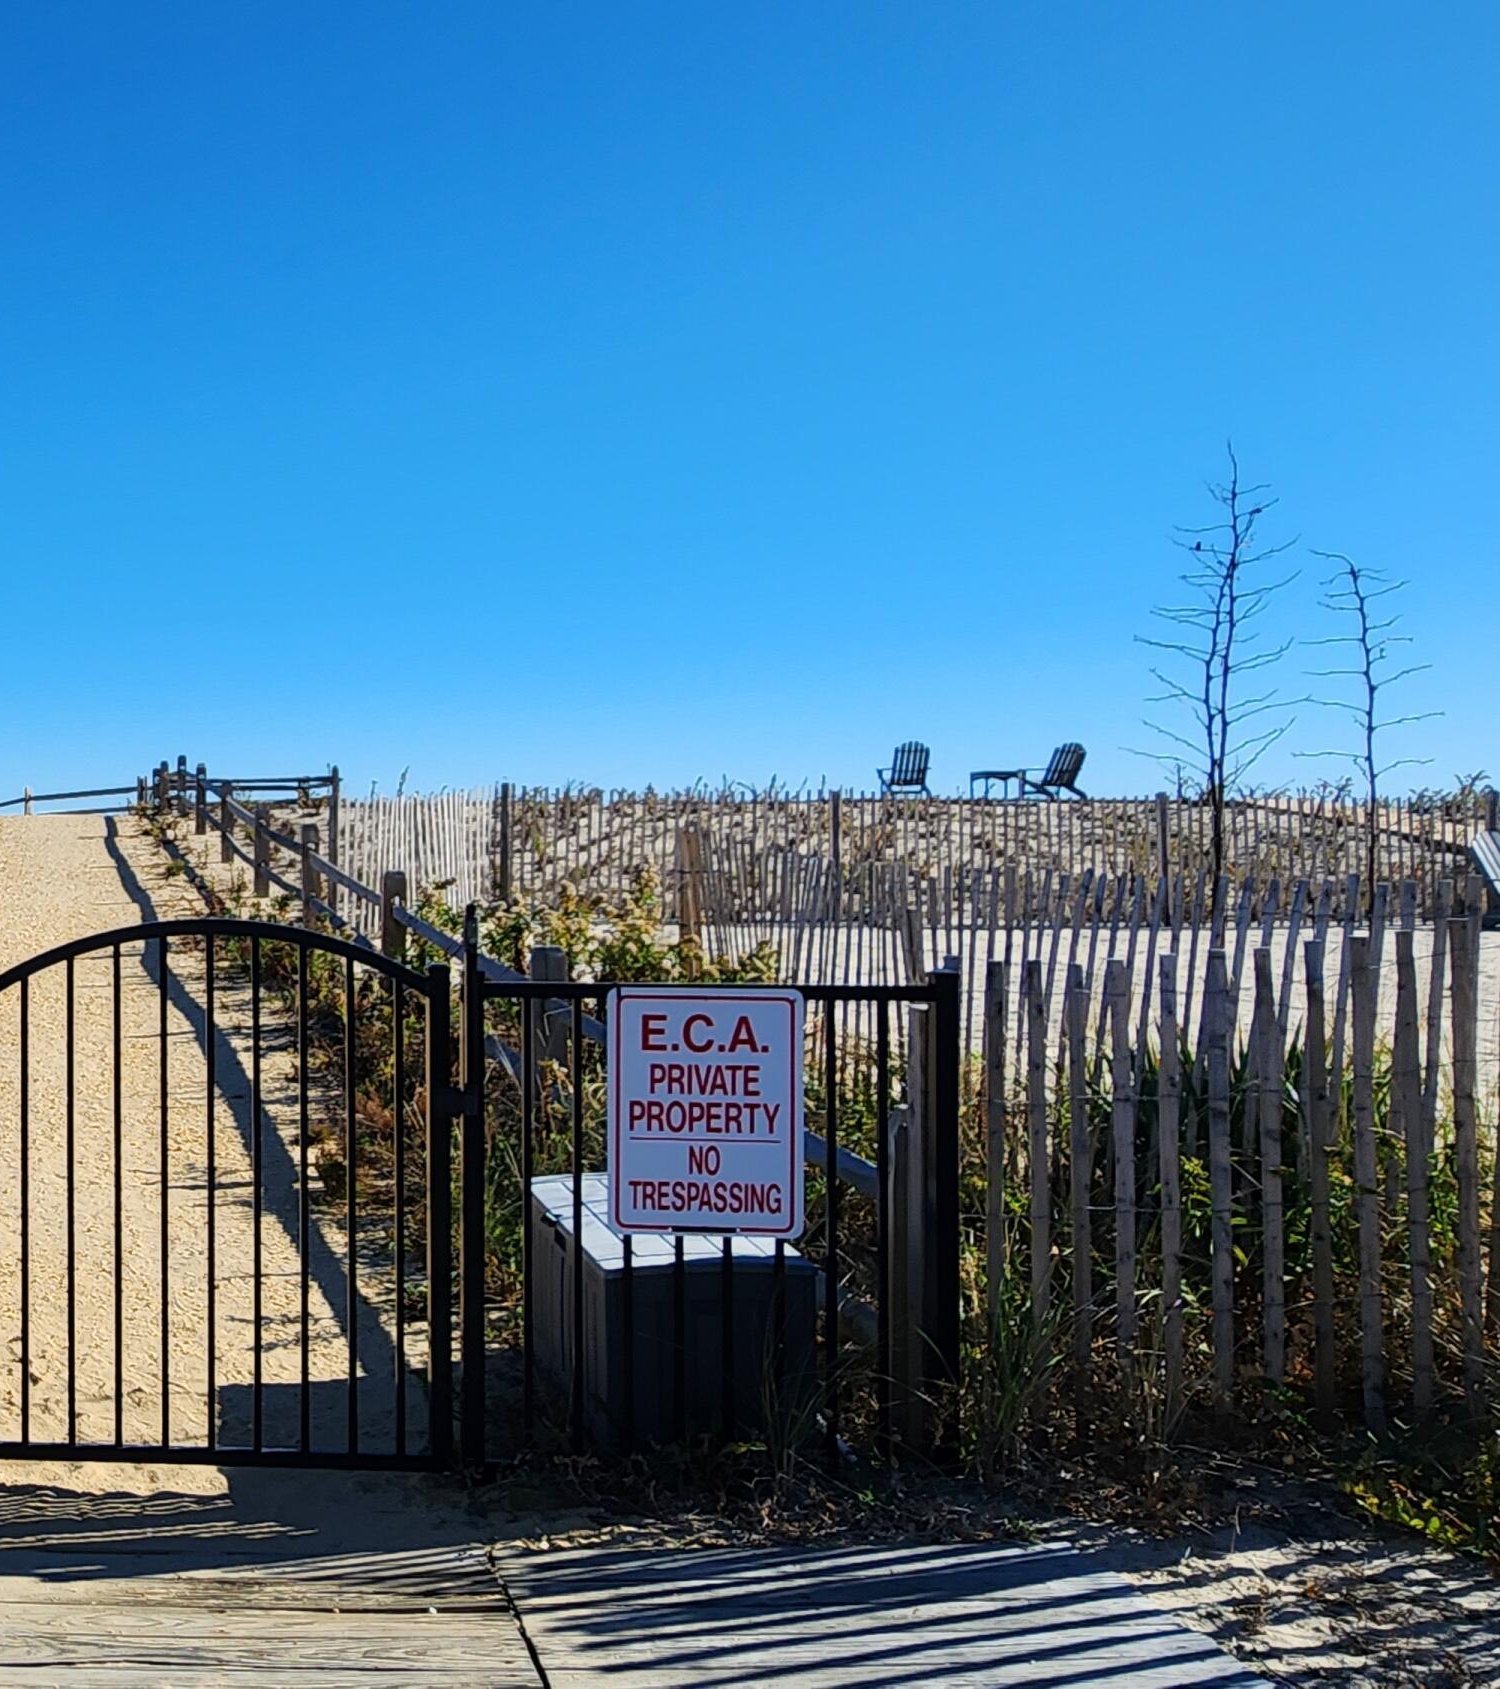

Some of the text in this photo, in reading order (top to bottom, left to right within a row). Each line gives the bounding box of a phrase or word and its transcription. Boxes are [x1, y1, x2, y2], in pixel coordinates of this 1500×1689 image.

[641, 1013, 770, 1053] E.C.A.
[649, 1063, 761, 1097] PRIVATE
[629, 1100, 781, 1134] PROPERTY
[688, 1145, 721, 1176] NO
[628, 1181, 782, 1214] TRESPASSING
